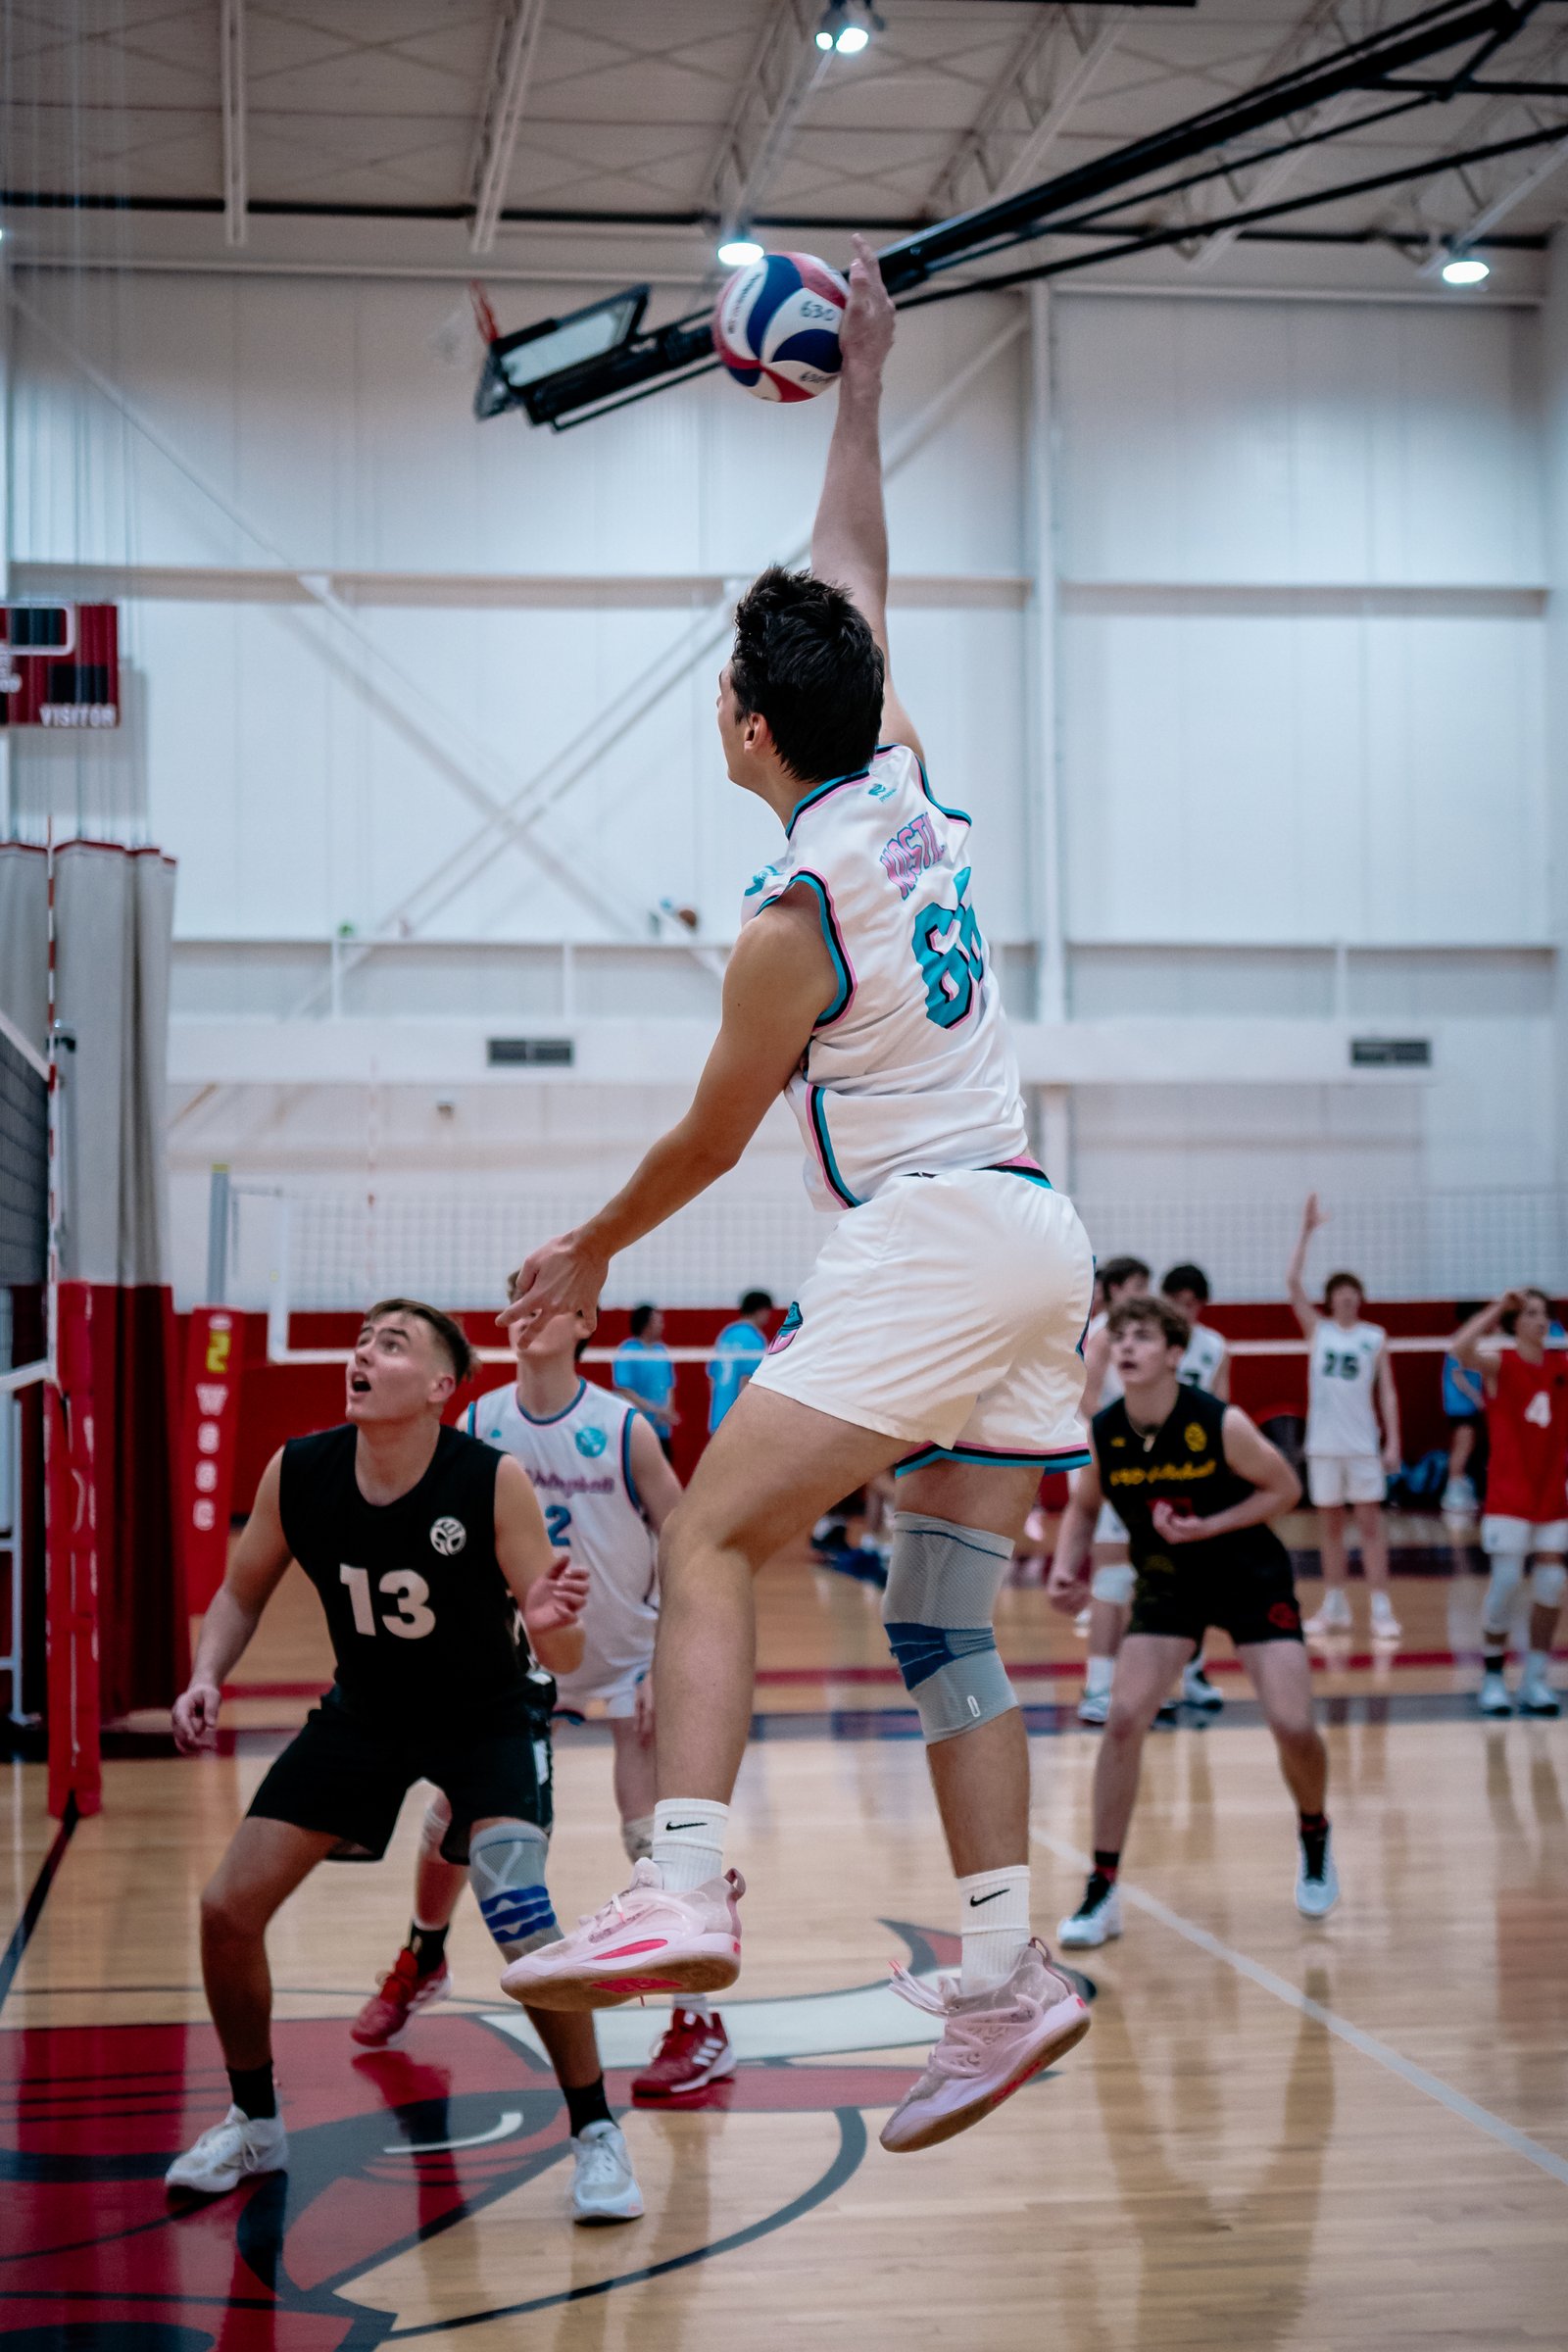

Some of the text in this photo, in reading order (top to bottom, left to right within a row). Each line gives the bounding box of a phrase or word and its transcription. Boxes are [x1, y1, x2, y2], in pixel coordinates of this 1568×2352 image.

[39, 703, 117, 727] VISITOR
[1525, 1391, 1551, 1428] 4
[545, 1504, 572, 1546] 2
[339, 1563, 437, 1640] 13
